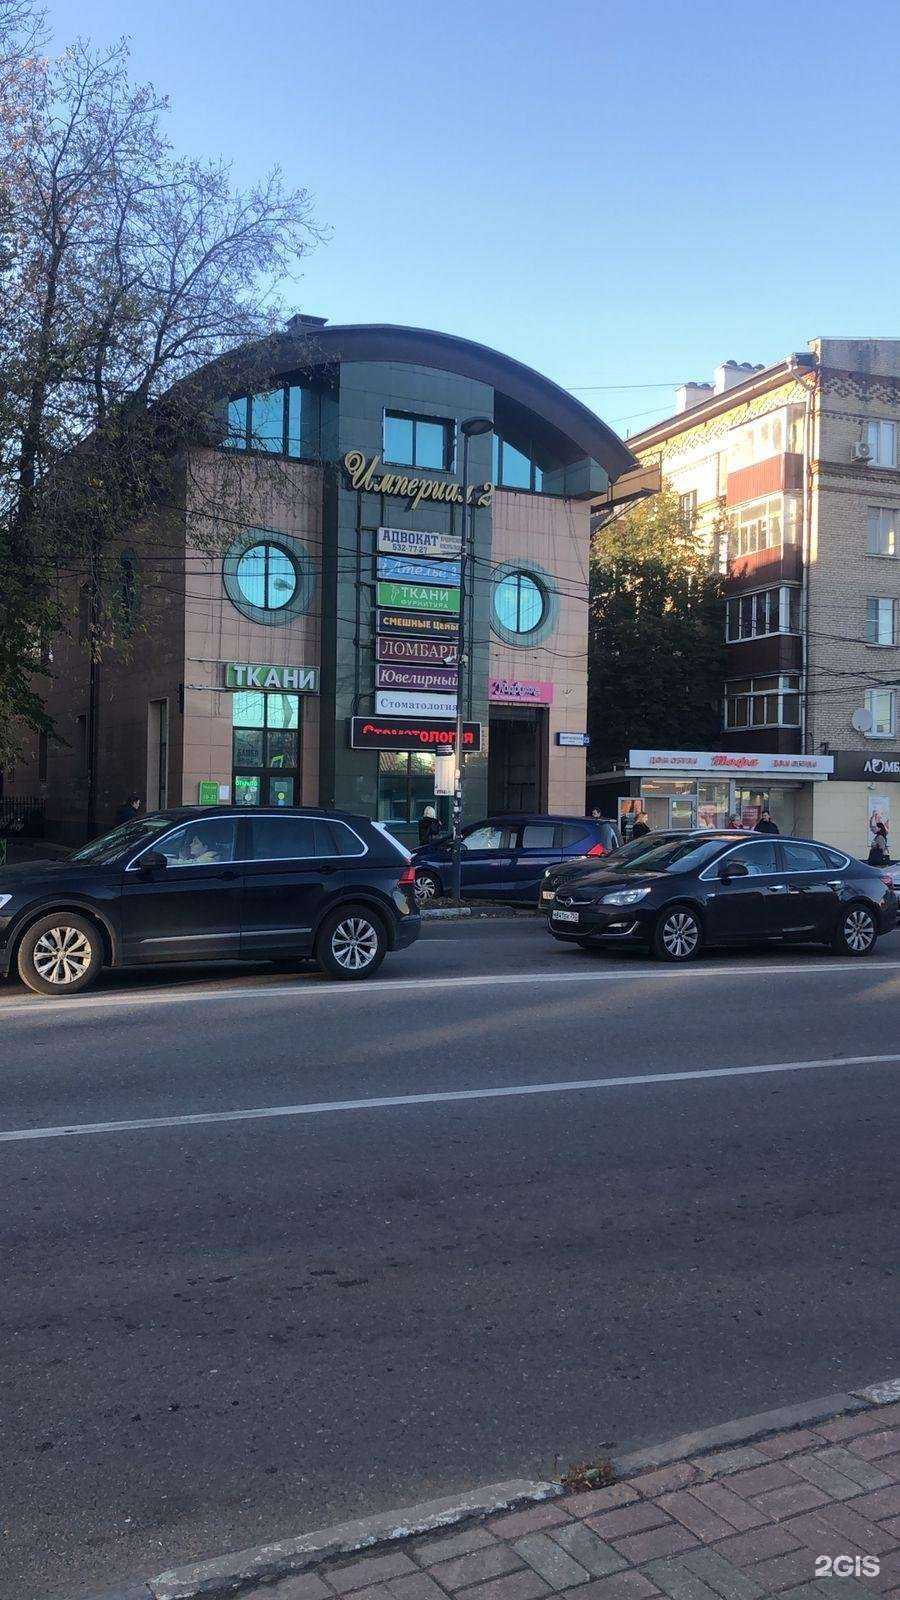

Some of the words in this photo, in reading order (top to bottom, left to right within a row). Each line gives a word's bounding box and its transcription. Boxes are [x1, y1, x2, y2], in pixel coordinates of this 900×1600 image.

[478, 481, 495, 507] 2
[382, 529, 439, 546] АДВОКАТ
[401, 586, 449, 602] ТКАНИ
[400, 599, 449, 609] ФУРНИТУРА
[383, 616, 431, 629] СМЕШНЫЕ
[382, 640, 458, 661] ЛОМБАРД
[233, 663, 316, 690] ТКАНИ
[380, 668, 459, 688] Ювелирный
[380, 698, 458, 712] Стоматология
